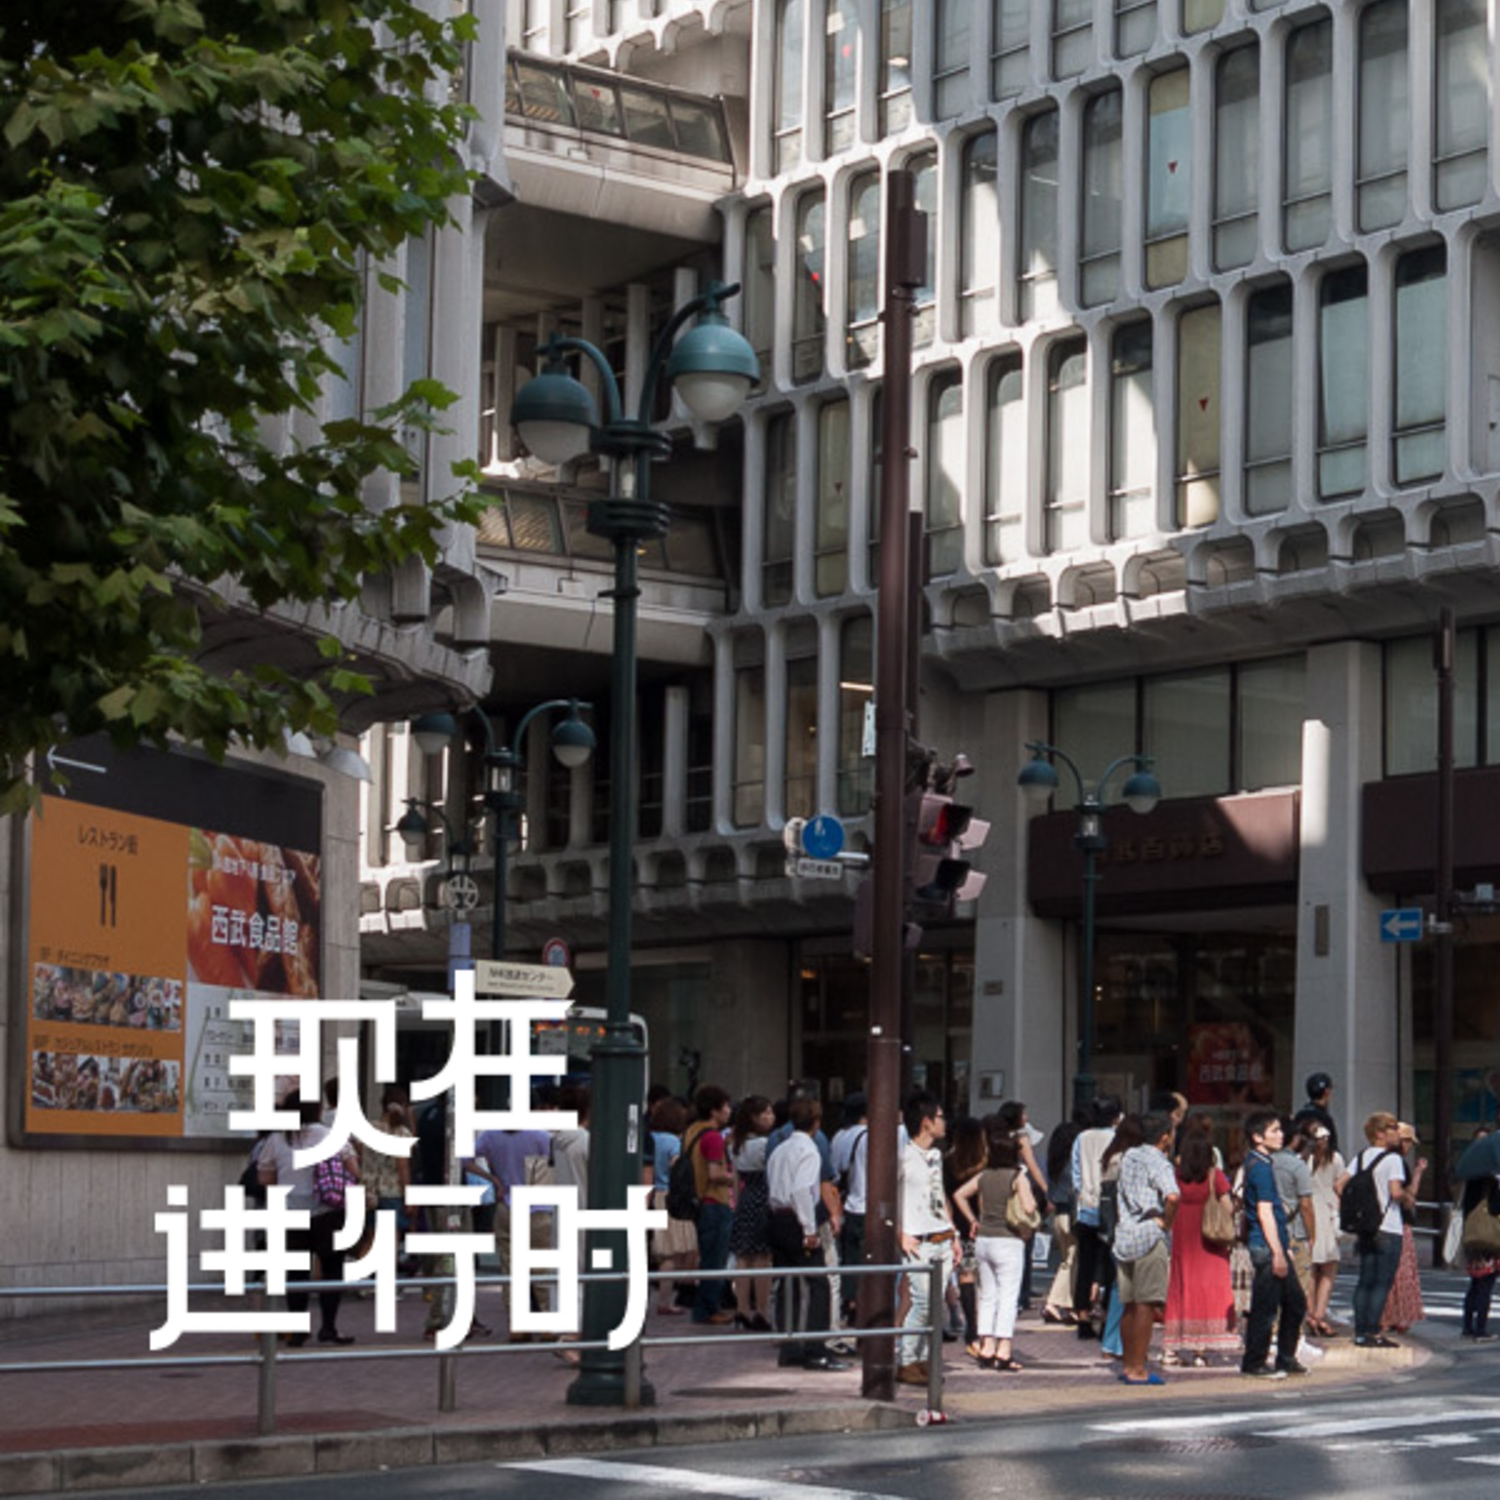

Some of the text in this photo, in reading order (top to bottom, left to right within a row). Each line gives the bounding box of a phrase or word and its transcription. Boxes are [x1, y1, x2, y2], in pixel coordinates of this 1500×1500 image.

[78, 824, 138, 856] レストラン街
[211, 904, 299, 956] 西武食品館
